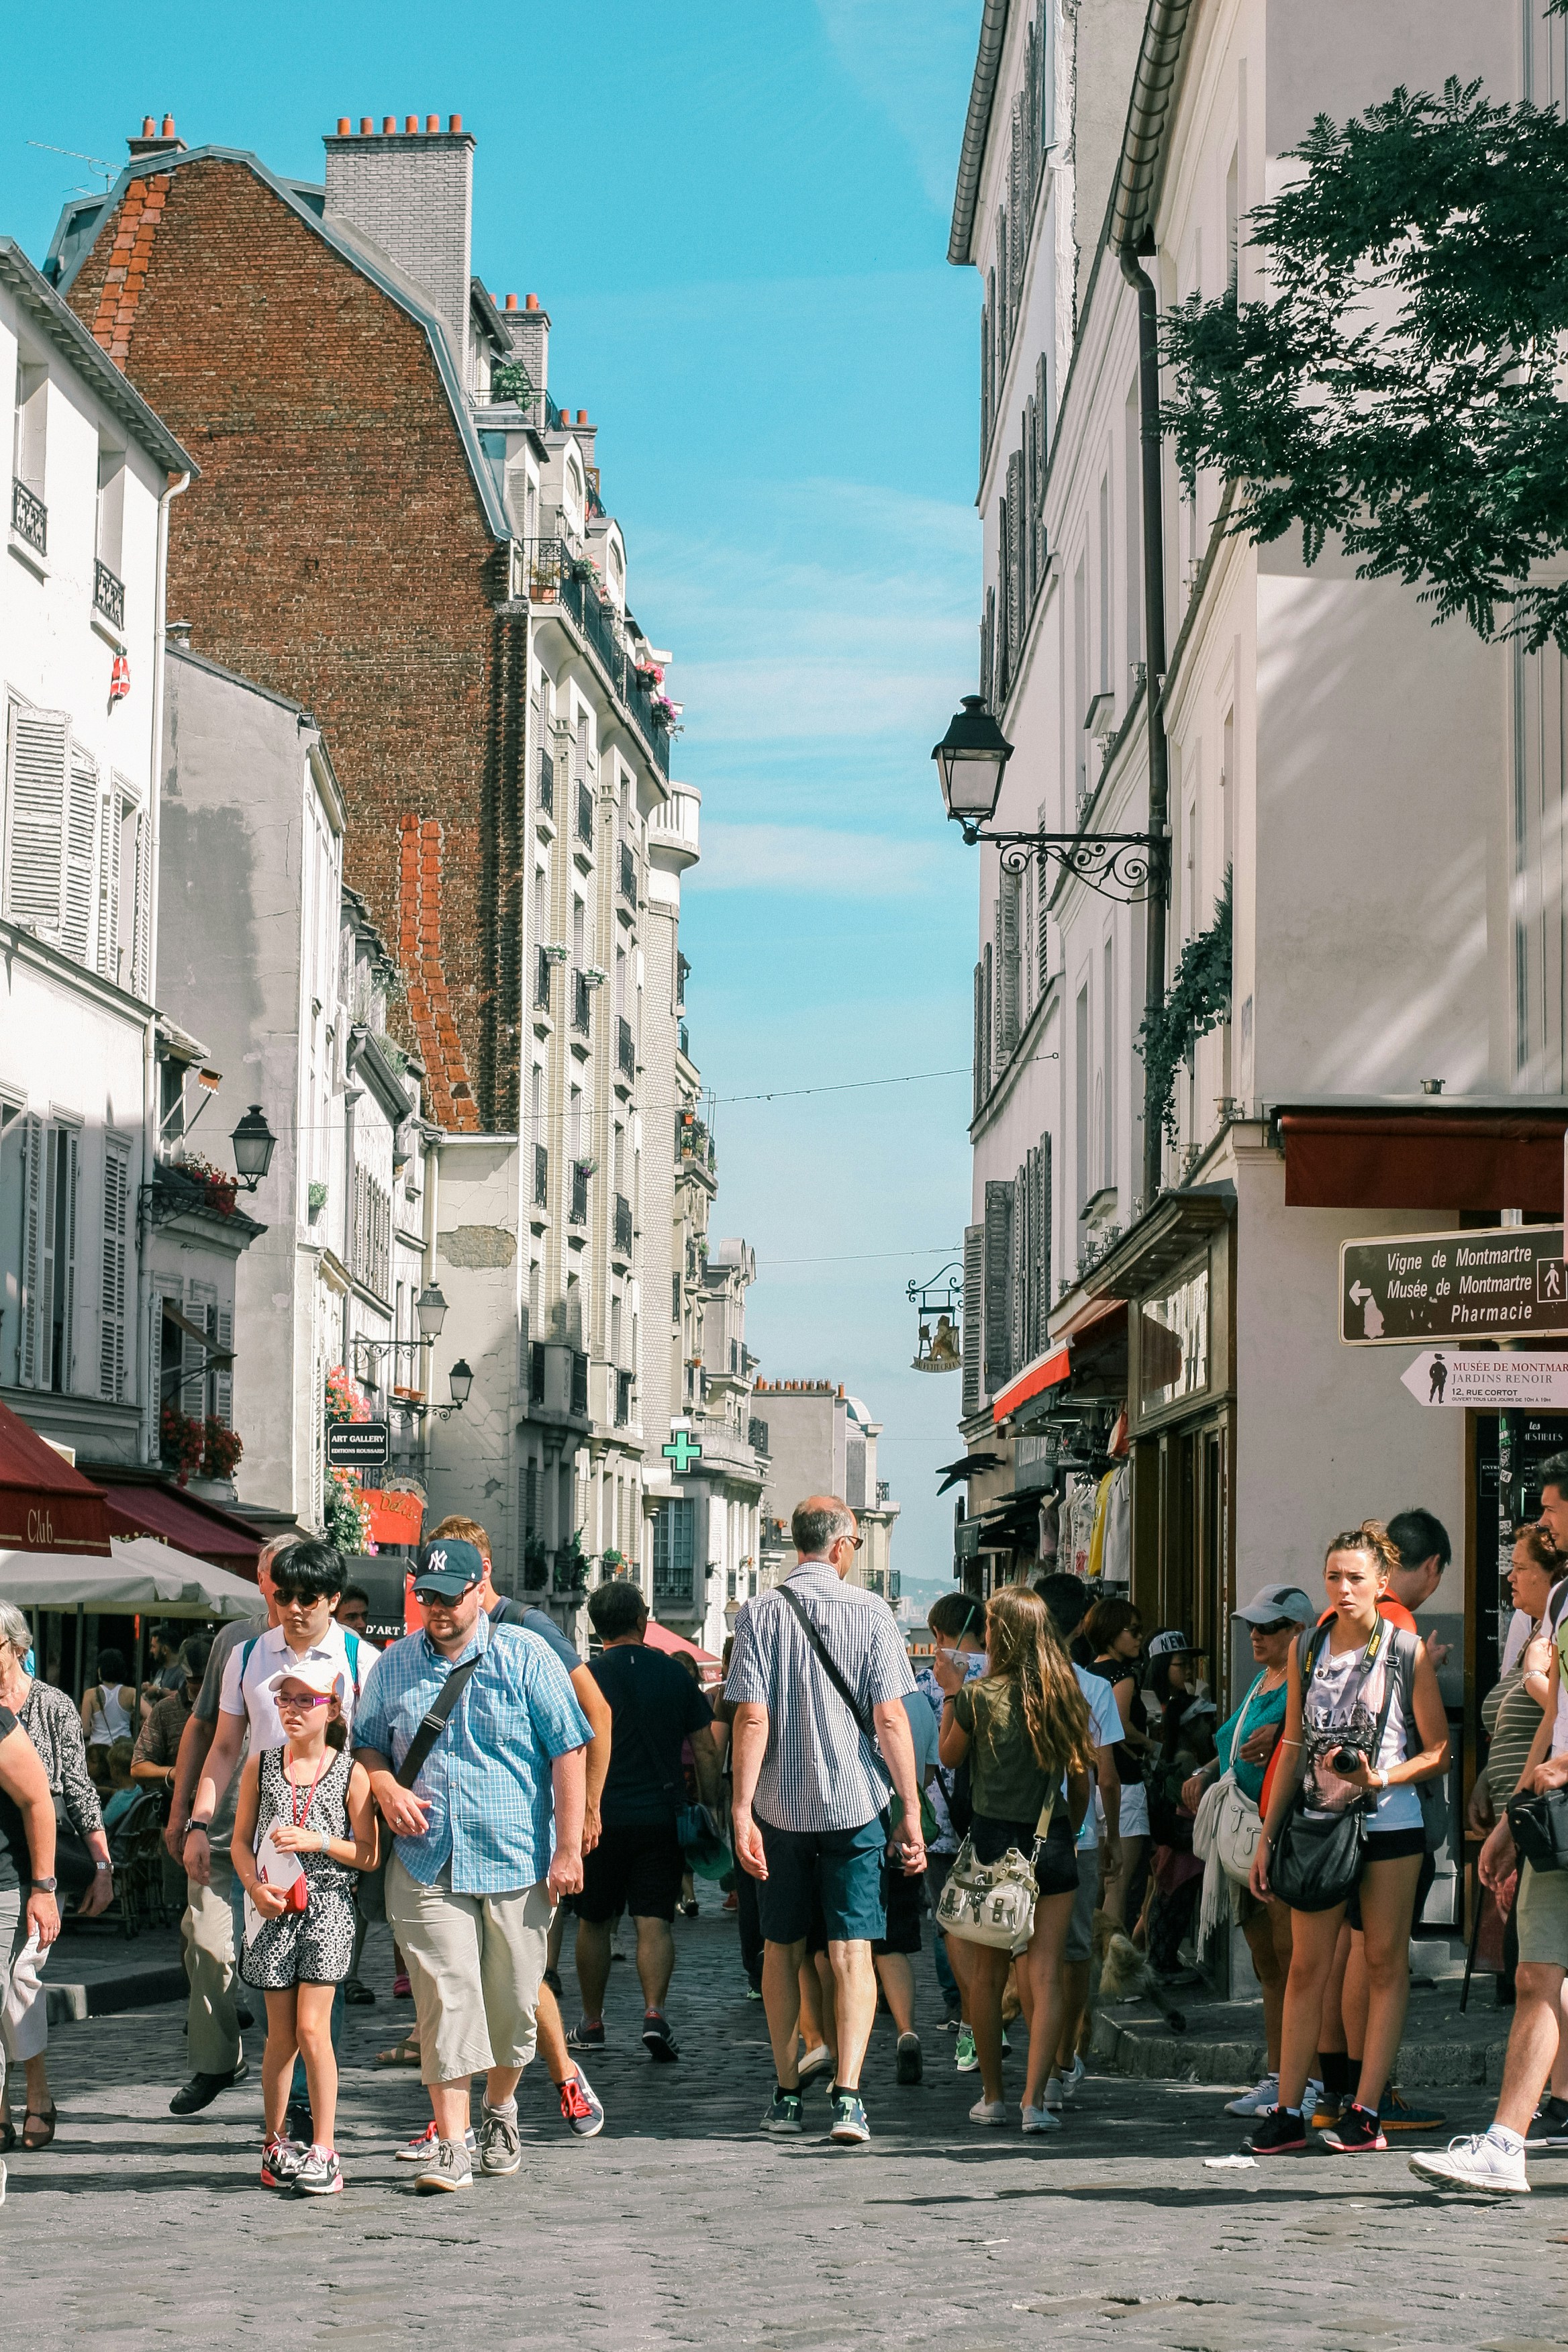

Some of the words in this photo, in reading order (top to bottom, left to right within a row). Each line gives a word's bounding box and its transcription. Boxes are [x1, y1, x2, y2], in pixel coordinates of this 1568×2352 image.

[1387, 1253, 1422, 1275] Vigne
[1431, 1250, 1447, 1268] de
[1456, 1246, 1532, 1267] Montmartre
[1387, 1279, 1428, 1299] Musée
[1436, 1277, 1451, 1295] de
[1459, 1275, 1532, 1294] Montmartre
[1451, 1301, 1532, 1322] Pharmacie
[1453, 1361, 1490, 1371] MUSÉE
[1493, 1363, 1508, 1371] DE
[1451, 1374, 1501, 1385] JARDINS
[1506, 1375, 1553, 1383] RENOIR
[1452, 1388, 1464, 1396] 12,
[28, 1509, 53, 1543] Club
[366, 1624, 401, 1636] D'ART
[1369, 1634, 1380, 1656] Nikon
